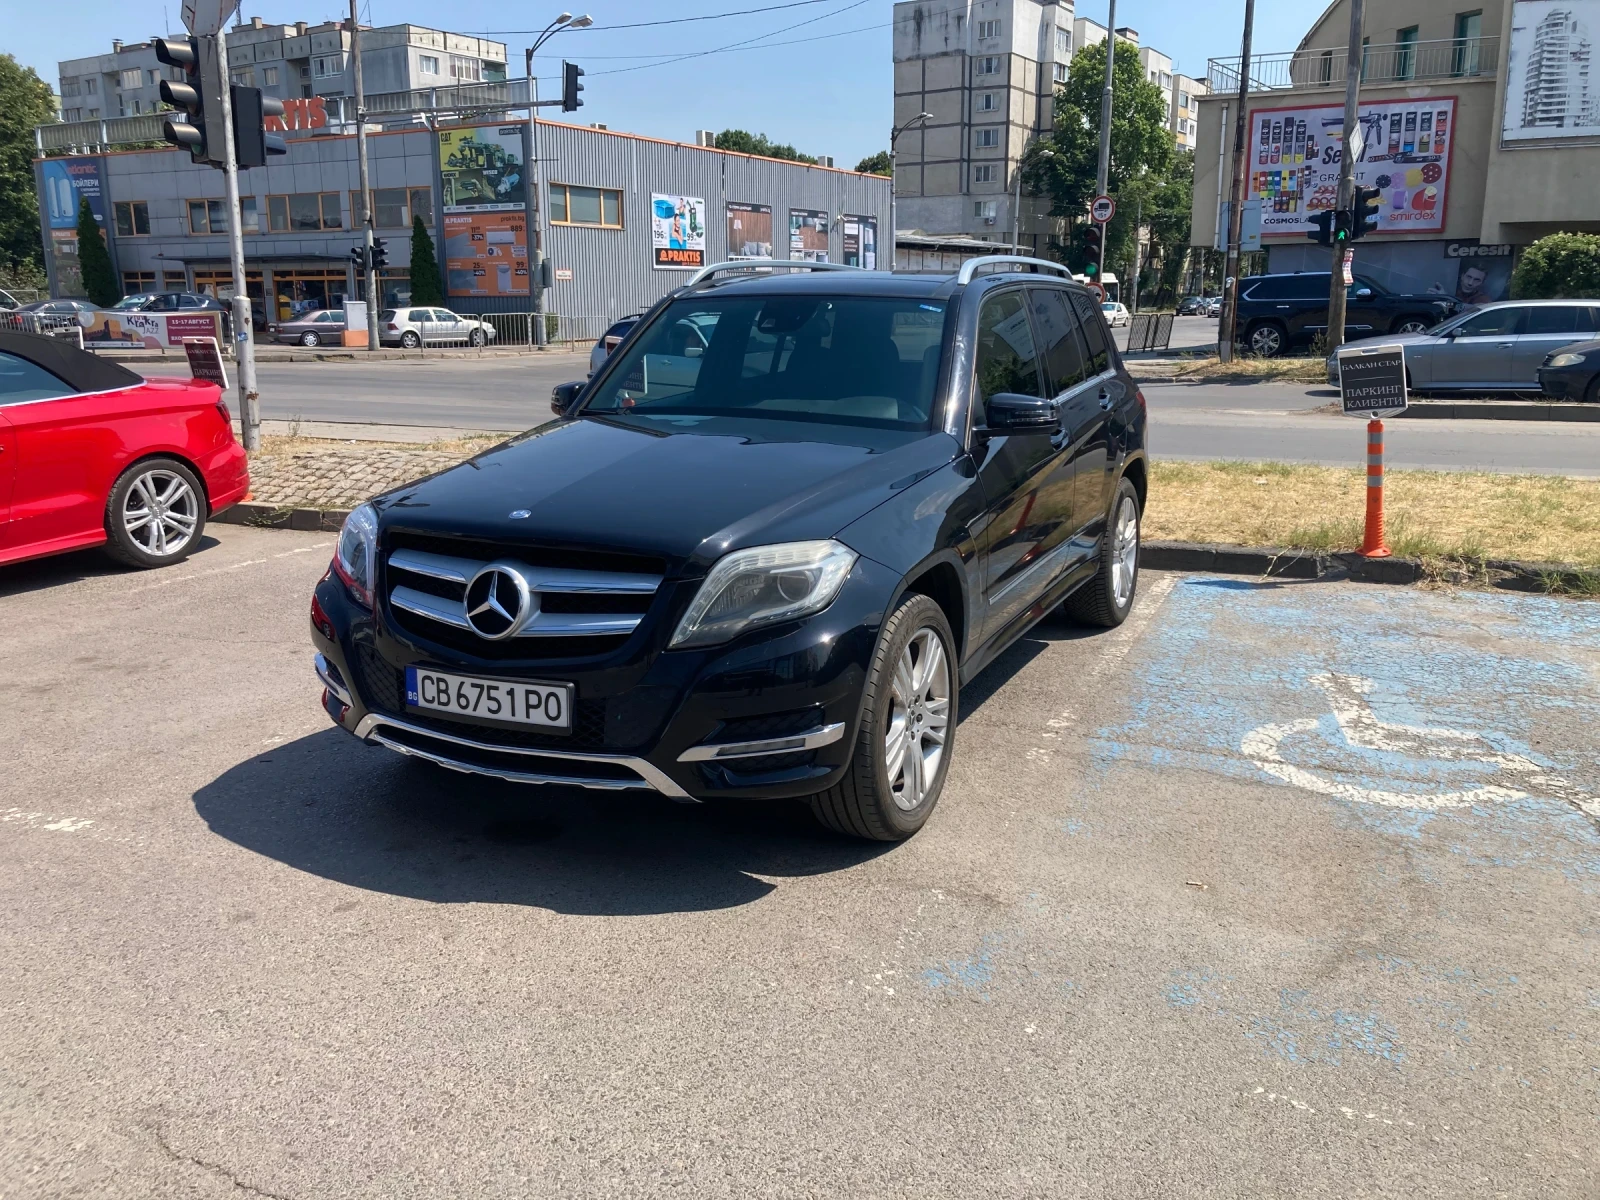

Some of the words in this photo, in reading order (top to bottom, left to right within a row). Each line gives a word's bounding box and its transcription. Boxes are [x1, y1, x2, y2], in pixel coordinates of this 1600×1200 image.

[440, 132, 452, 142] CAT
[72, 178, 100, 188] БОЙЛЕРИ
[1390, 210, 1436, 221] smirdex
[654, 230, 664, 239] 196
[687, 232, 694, 240] 99
[1448, 244, 1510, 256] Ceresit
[668, 250, 700, 262] PRAKTIS
[1342, 362, 1377, 370] БАЛКАН
[1346, 385, 1402, 398] ПАРКИНГ
[1347, 397, 1402, 408] КЛИЕНТИ
[408, 691, 418, 700] BG
[456, 681, 516, 717] 6751
